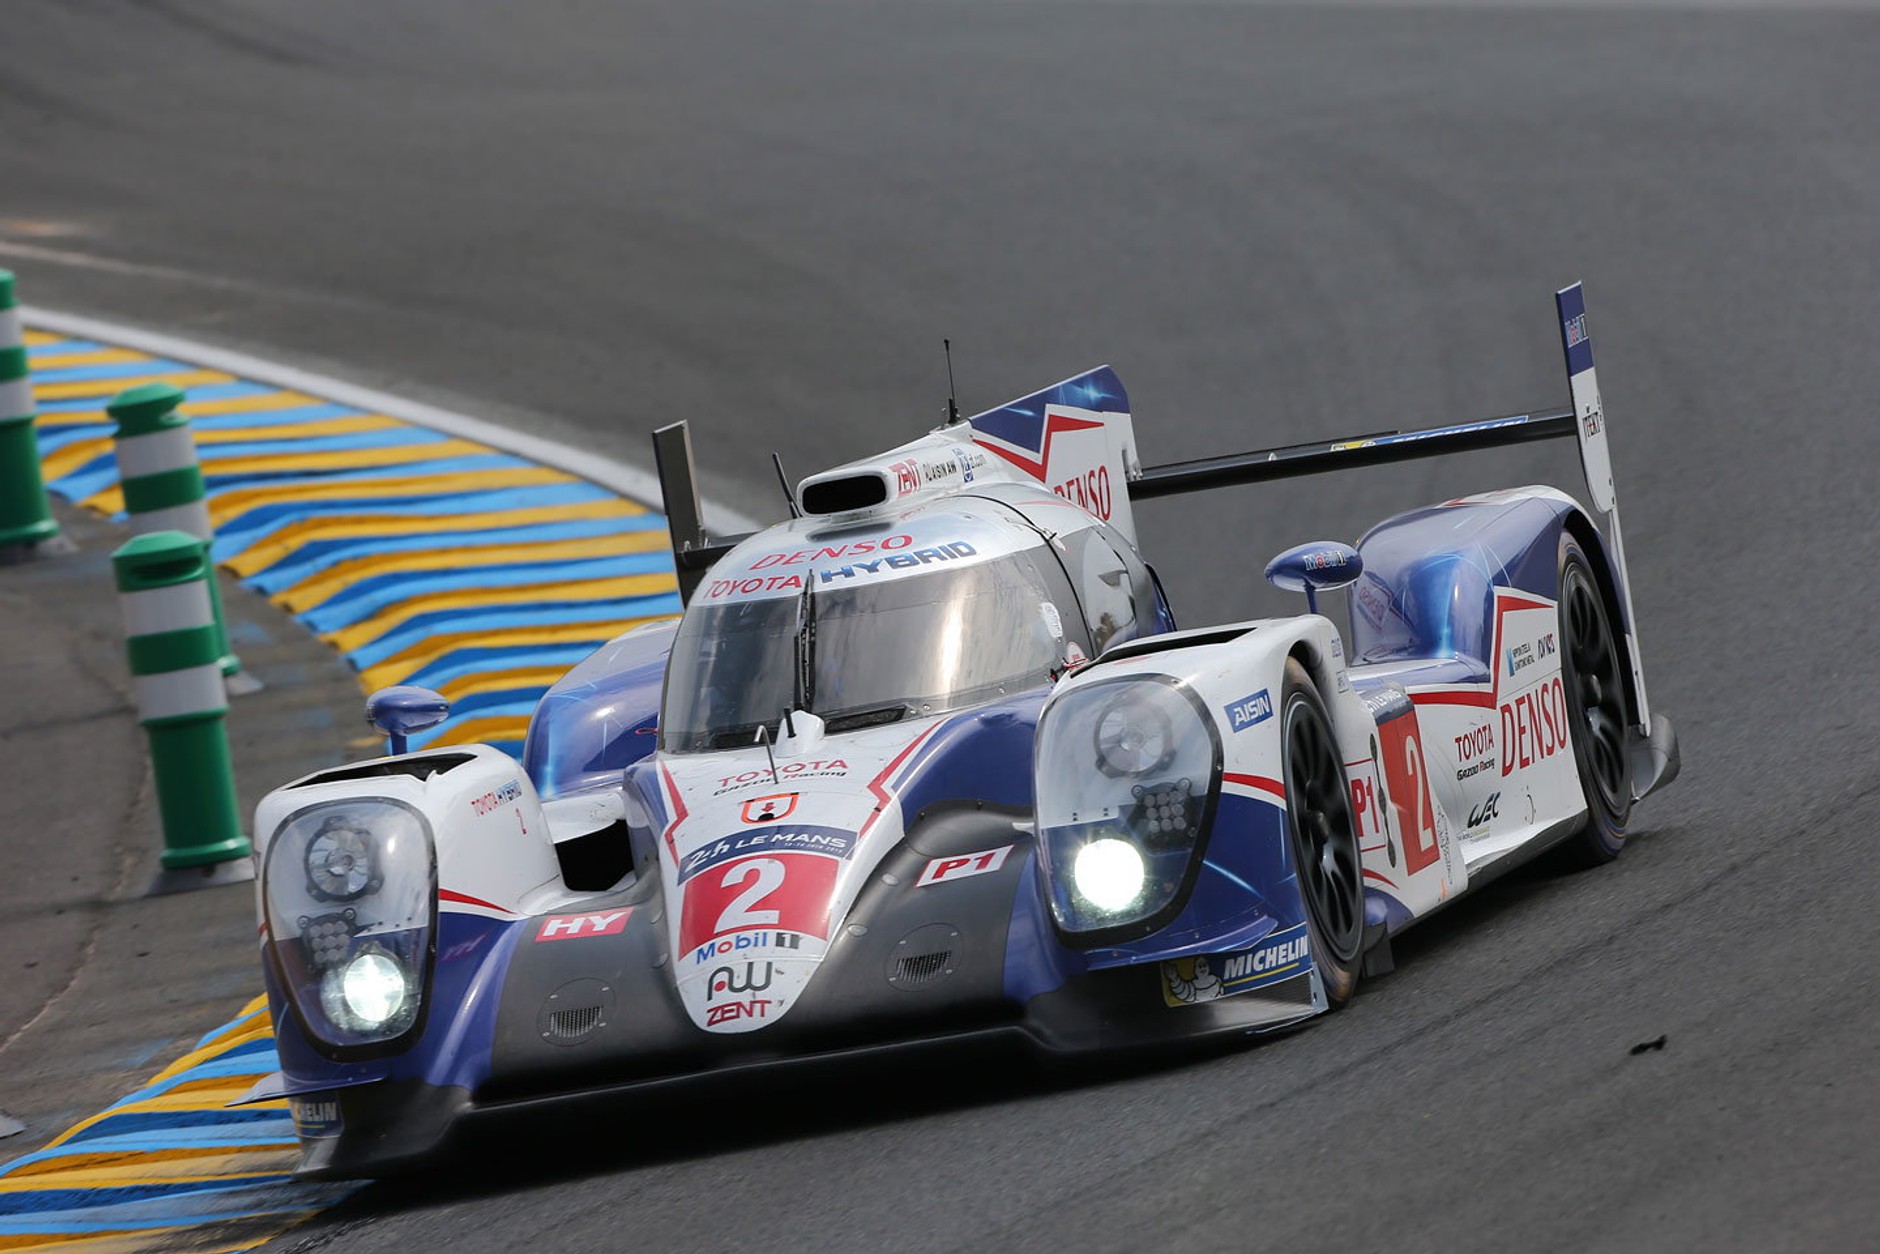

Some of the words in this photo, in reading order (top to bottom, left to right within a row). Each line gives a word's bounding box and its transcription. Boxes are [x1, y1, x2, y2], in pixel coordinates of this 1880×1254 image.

[1054, 465, 1111, 521] NSO
[703, 574, 802, 599] TOYOTA
[820, 540, 978, 584] HYBRID
[749, 535, 912, 571] DENSO
[1233, 694, 1272, 727] AISIN
[1500, 677, 1567, 777] DENSO
[1455, 723, 1495, 763] TOYOTA
[718, 759, 849, 788] TOYOTA
[1351, 775, 1380, 838] P1
[1404, 735, 1435, 852] 2
[1467, 791, 1501, 829] WEC
[735, 834, 769, 850] LE
[770, 833, 847, 849] MANS
[931, 852, 996, 880] P1
[714, 858, 786, 934] 2
[541, 911, 627, 937] HY
[697, 932, 768, 965] Mobil
[1223, 935, 1309, 980] MICHELIN
[706, 1000, 772, 1027] ZENT
